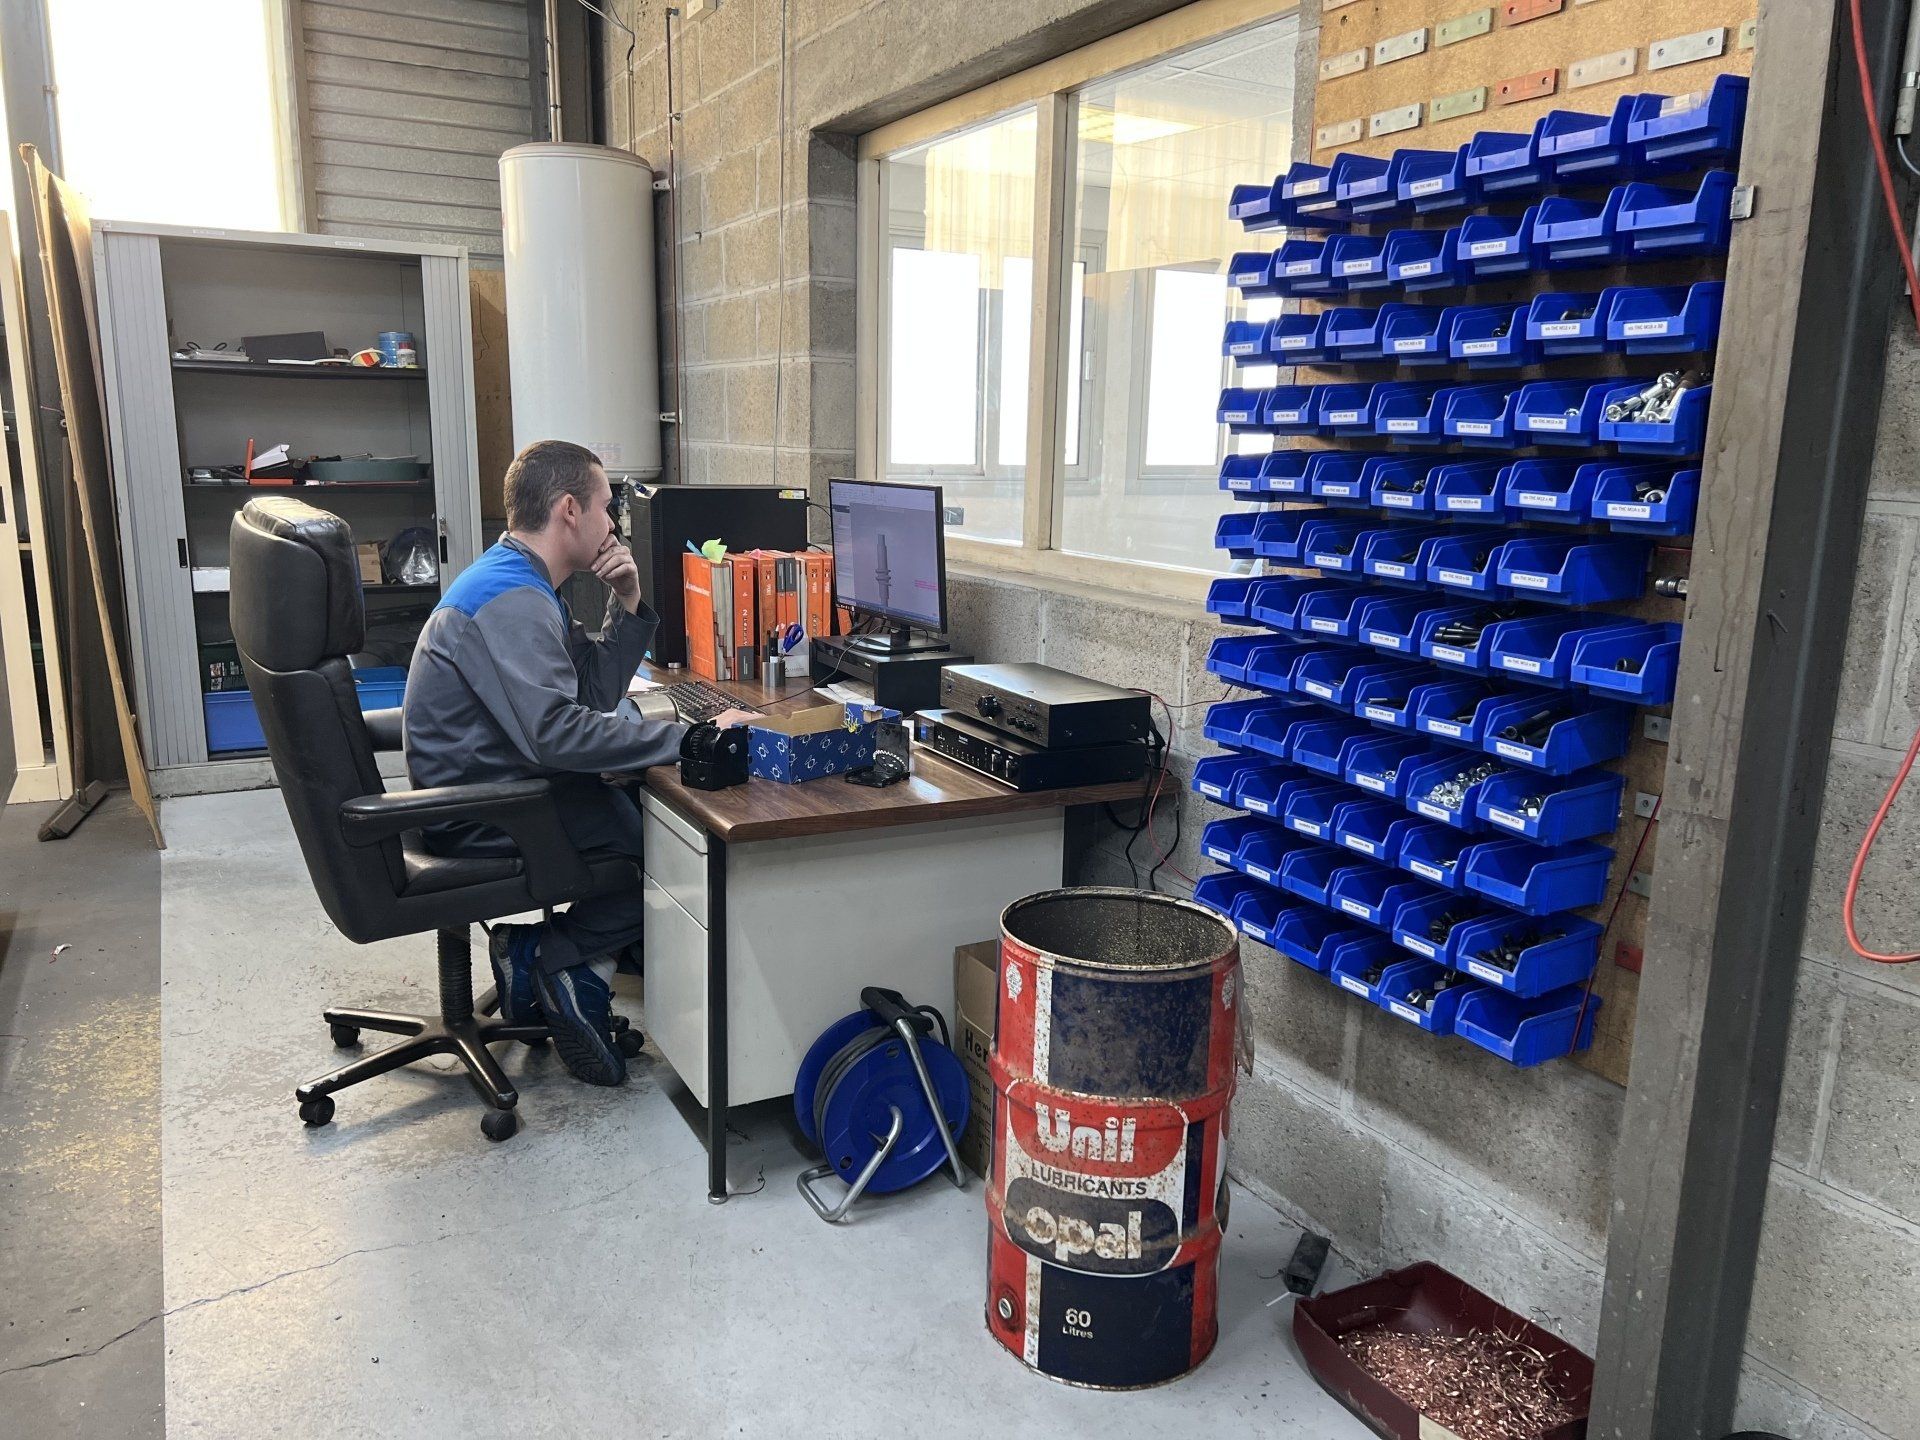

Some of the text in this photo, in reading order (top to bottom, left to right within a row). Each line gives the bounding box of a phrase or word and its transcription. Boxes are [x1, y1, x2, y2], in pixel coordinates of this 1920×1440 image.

[1036, 1101, 1137, 1163] Unil
[1031, 1162, 1147, 1197] LUBRICANTS
[1025, 1206, 1142, 1263] opal
[1062, 1325, 1094, 1340] Litres
[1065, 1308, 1092, 1328] 60
